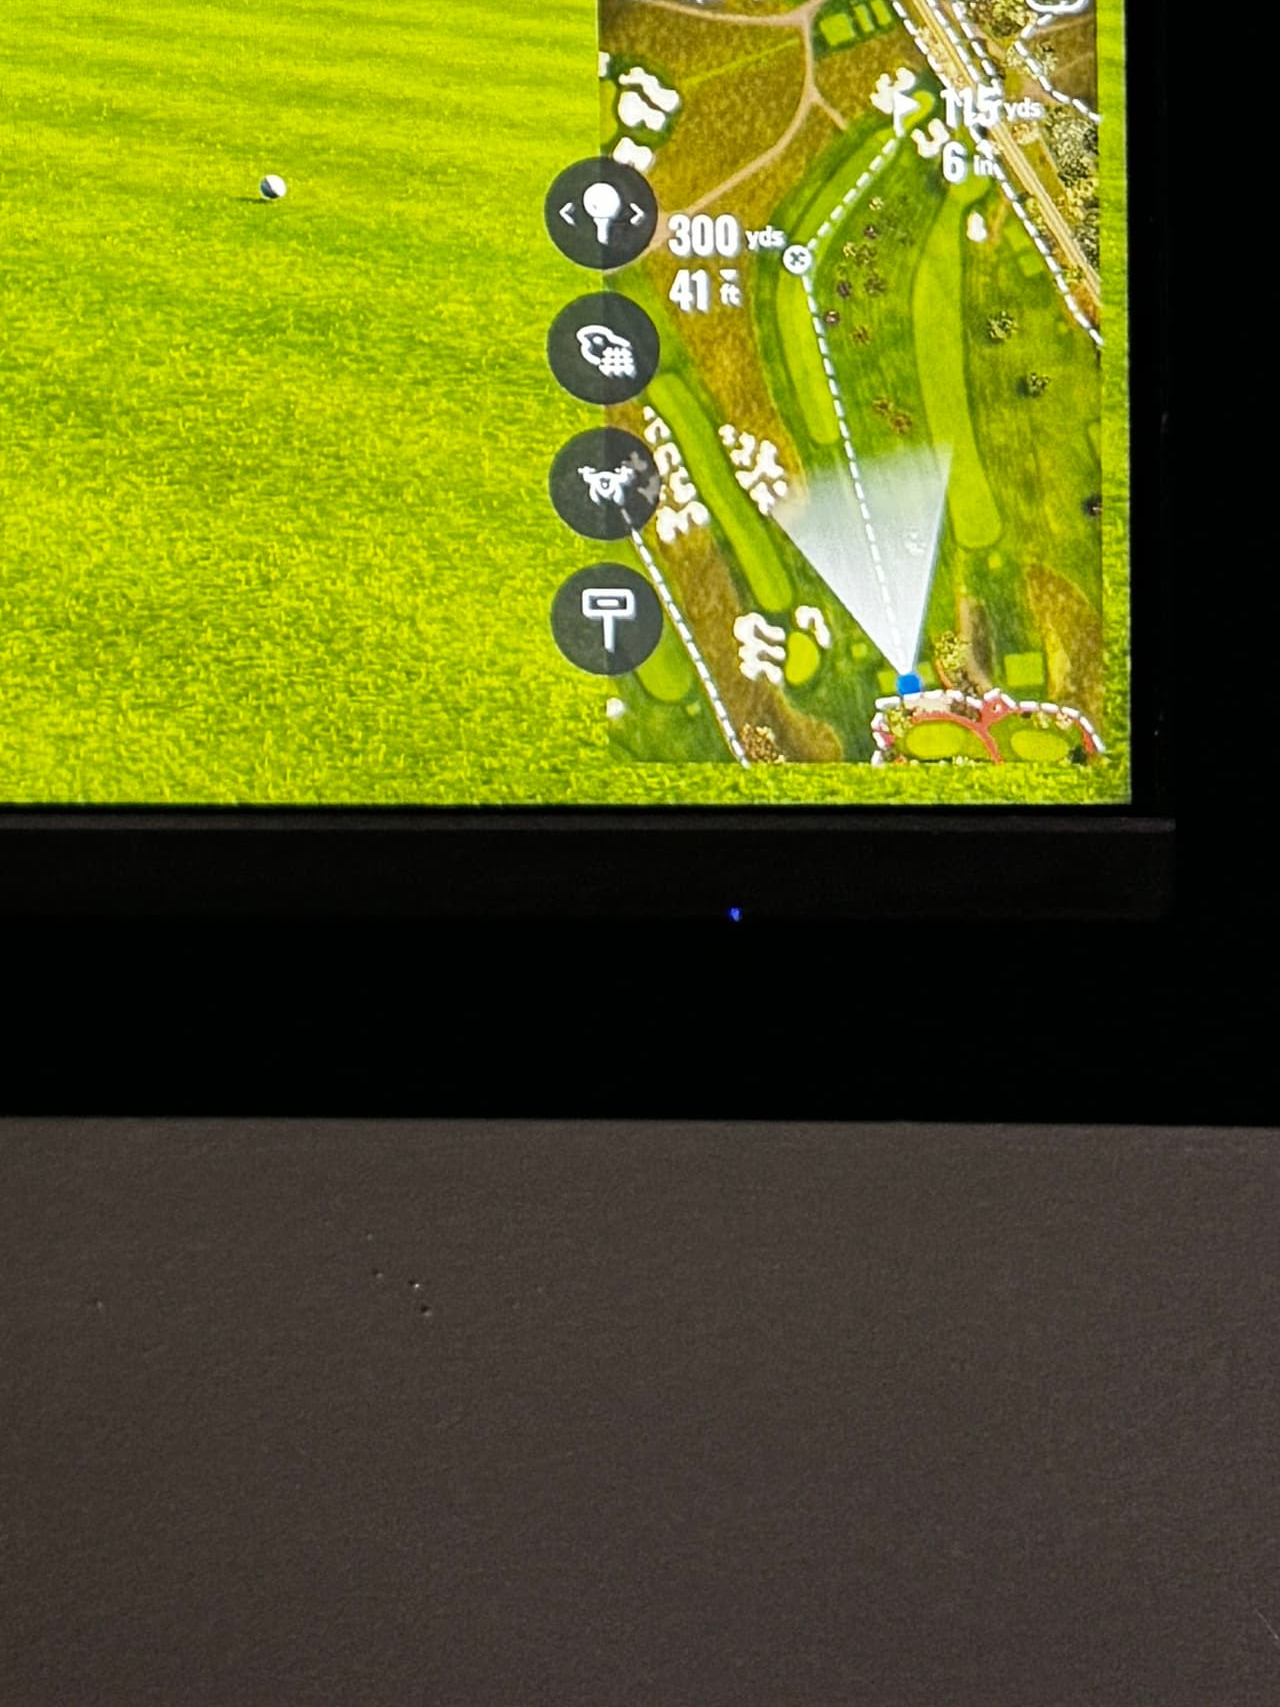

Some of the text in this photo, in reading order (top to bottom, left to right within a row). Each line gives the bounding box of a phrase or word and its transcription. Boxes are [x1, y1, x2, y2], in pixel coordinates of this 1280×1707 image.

[1003, 97, 1046, 122] yds
[942, 140, 968, 184] 6
[668, 213, 786, 258] 300 yds
[669, 268, 709, 314] 41
